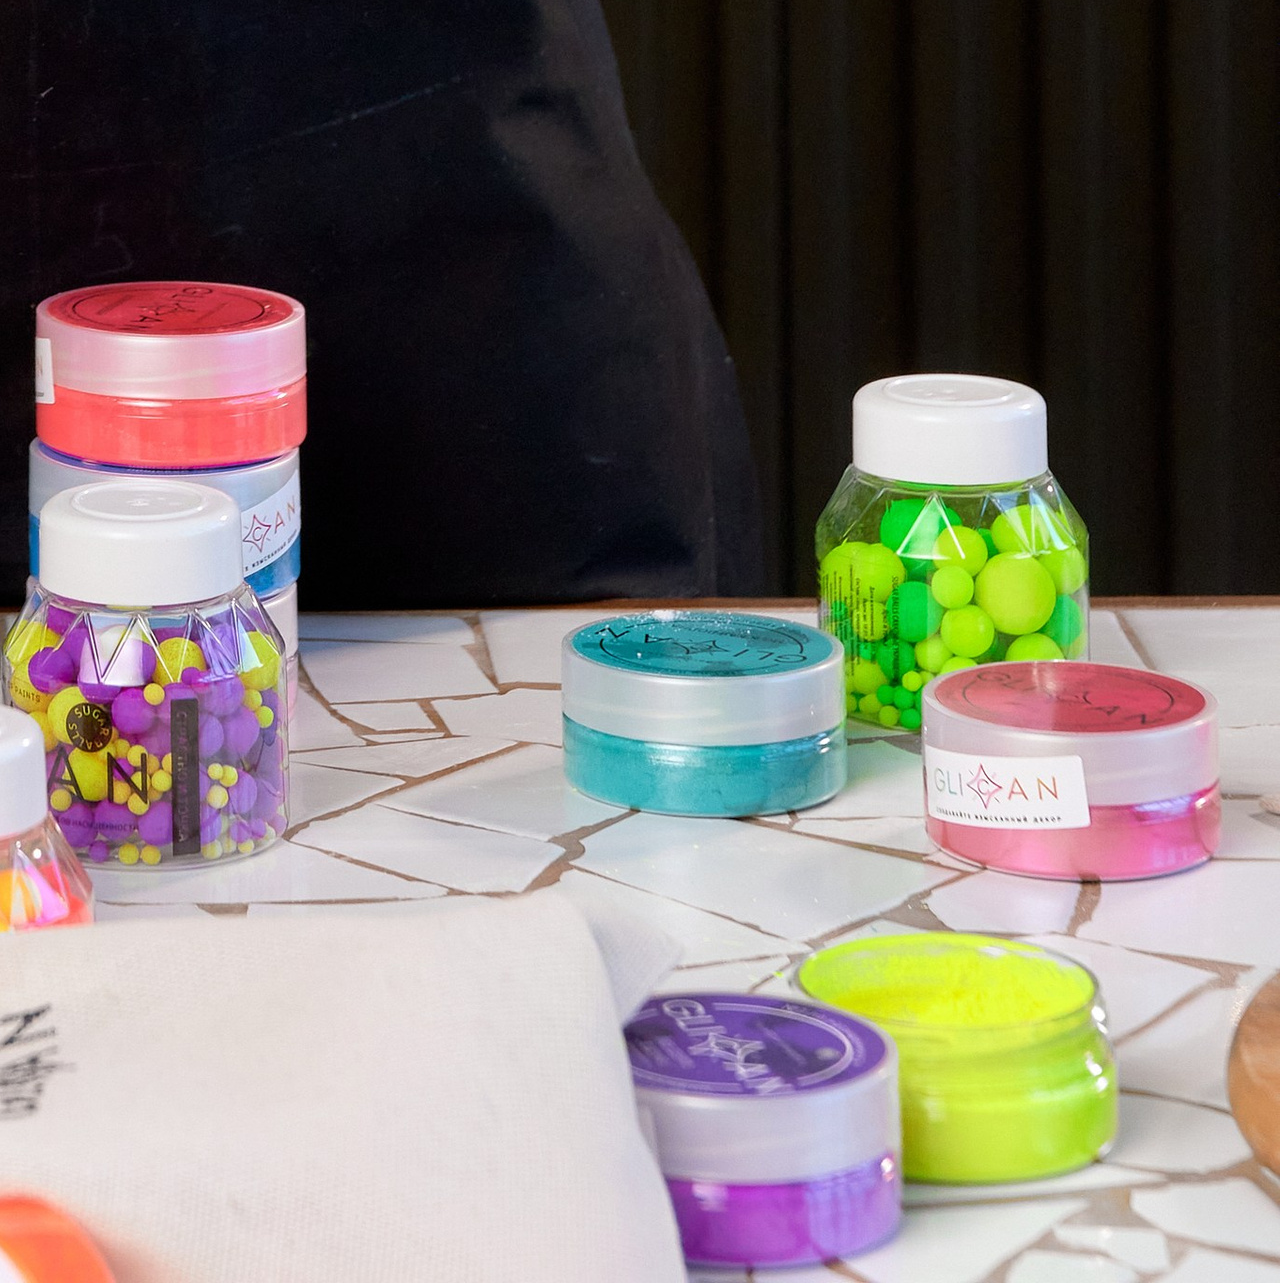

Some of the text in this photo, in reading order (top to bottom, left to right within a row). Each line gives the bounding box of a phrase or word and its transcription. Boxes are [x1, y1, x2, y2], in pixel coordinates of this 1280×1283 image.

[14, 686, 41, 703] PAINTS
[74, 705, 110, 737] SUGAR
[934, 763, 1059, 810] GLICAN
